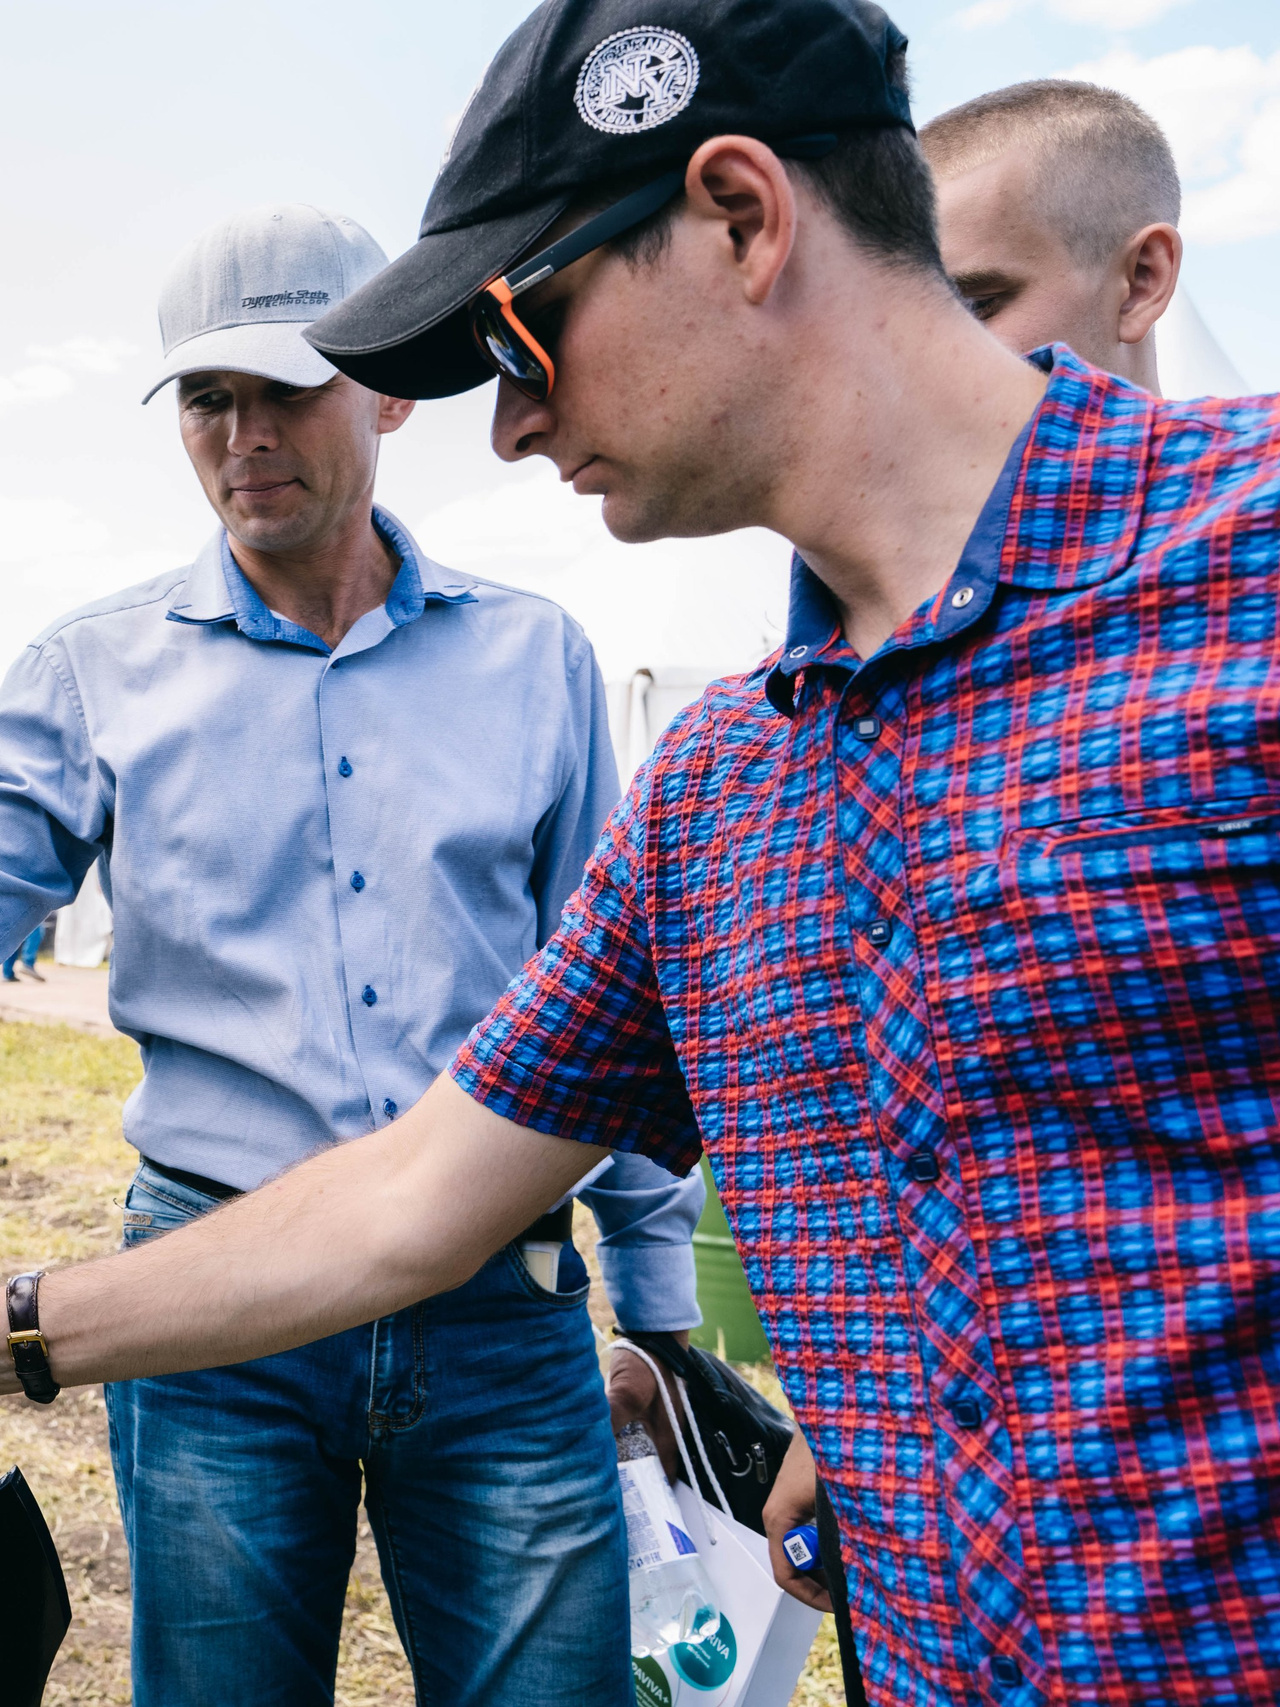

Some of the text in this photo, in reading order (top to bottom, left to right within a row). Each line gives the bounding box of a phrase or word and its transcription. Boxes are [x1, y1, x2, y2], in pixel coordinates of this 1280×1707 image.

[240, 289, 331, 310] Dynamic State
[257, 300, 329, 309] TECHNOLOGY
